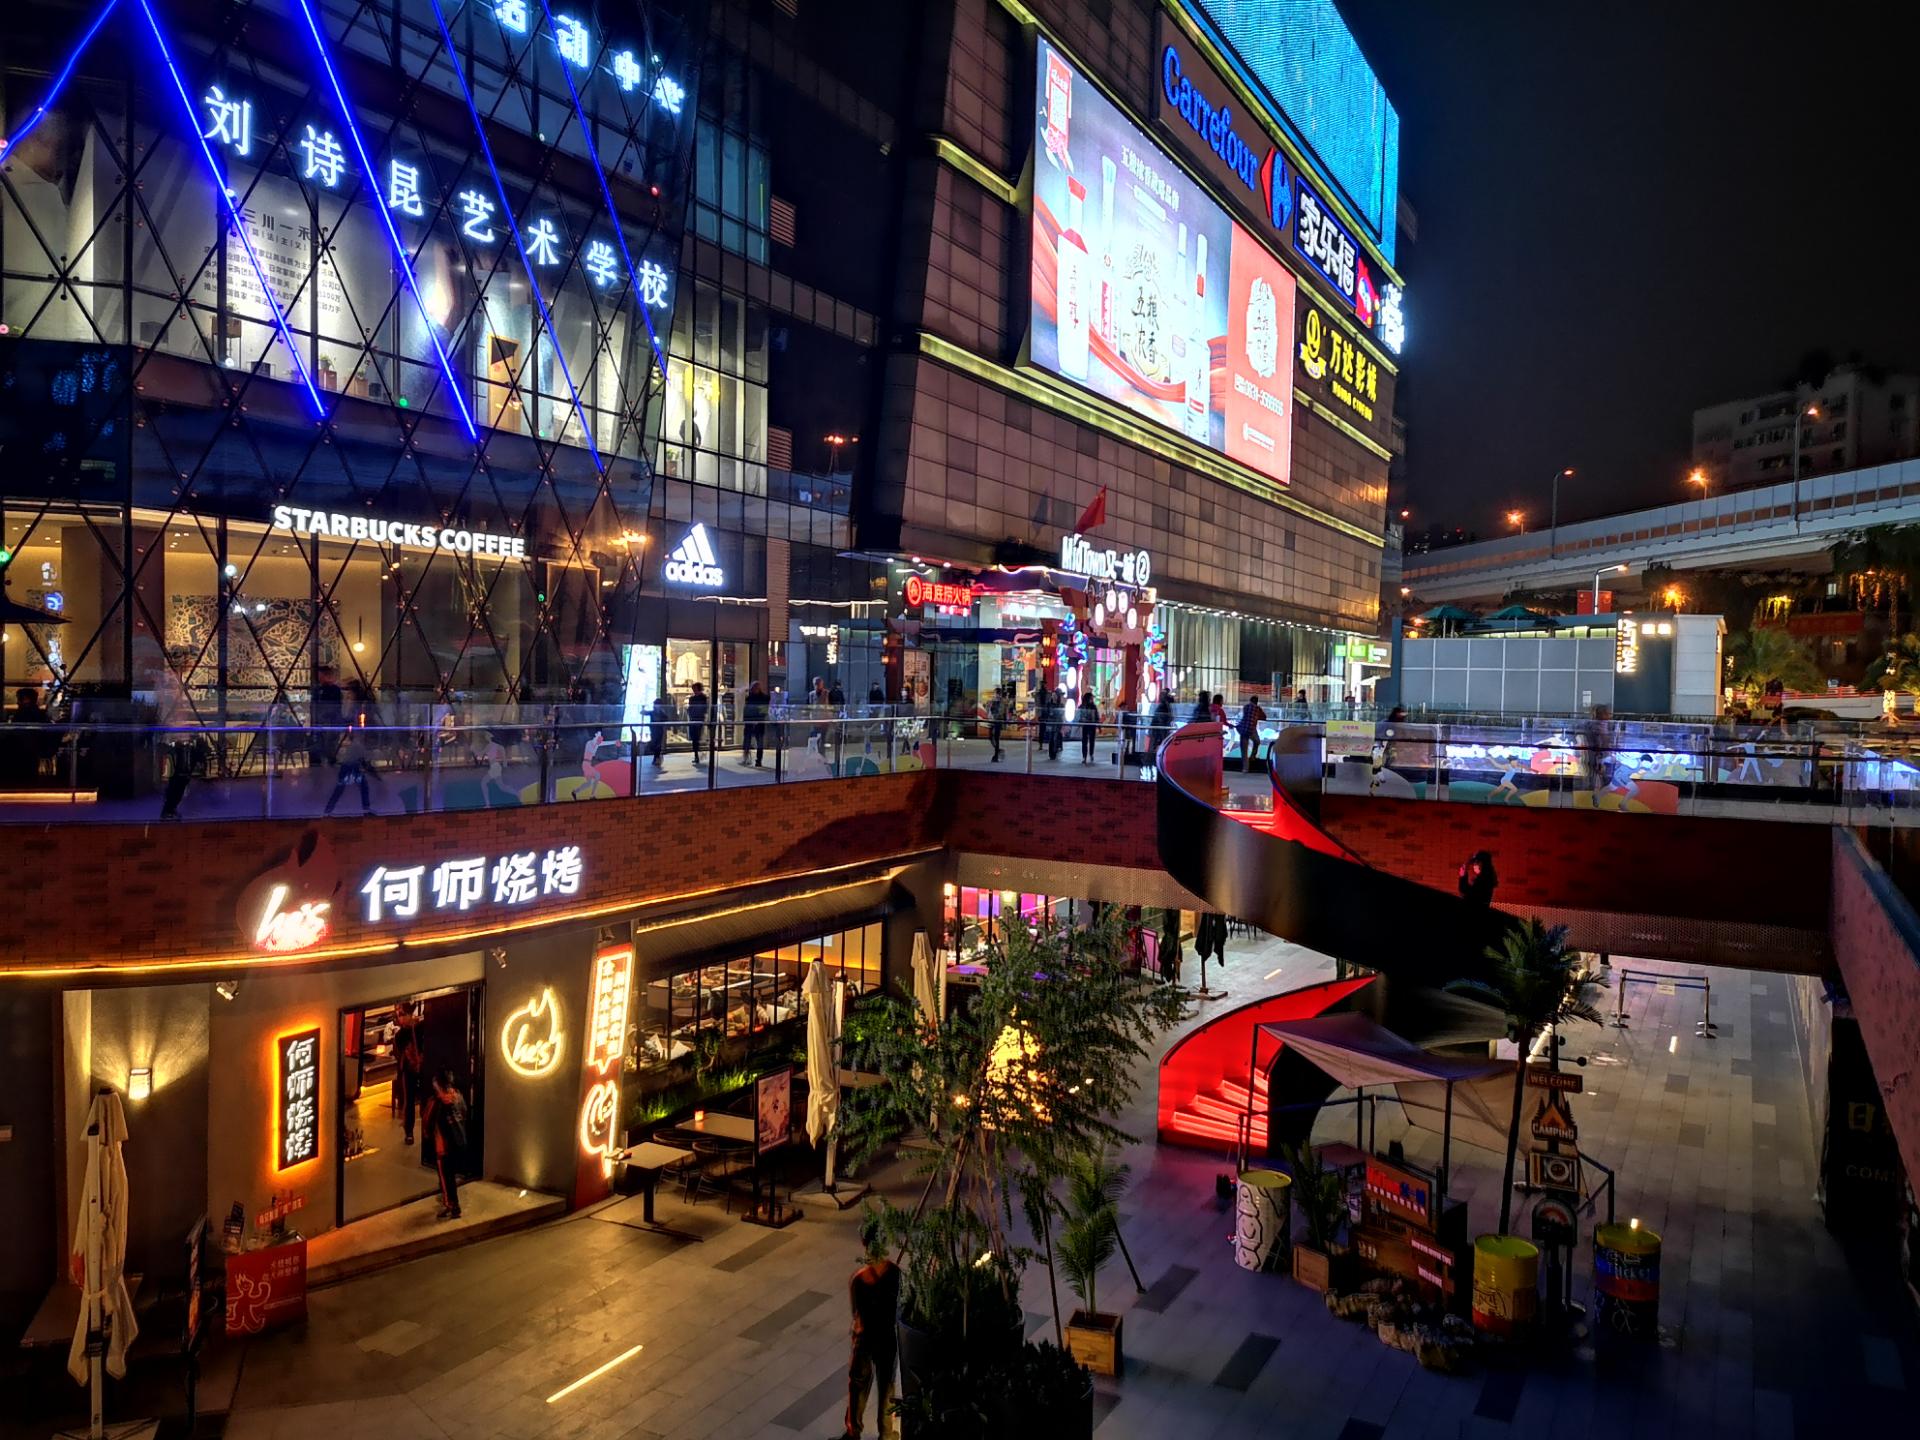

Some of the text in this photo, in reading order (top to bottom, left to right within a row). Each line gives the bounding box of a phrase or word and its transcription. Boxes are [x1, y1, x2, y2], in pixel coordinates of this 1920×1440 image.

[1162, 45, 1258, 192] Carrefour
[204, 85, 669, 309] 刘诗昆艺术学校
[1301, 192, 1356, 296] 家乐福
[1330, 329, 1377, 403] 万达影城
[273, 505, 525, 557] STARBUCKS COFFEE
[665, 560, 723, 587] adidas
[922, 582, 971, 606] 海底捞火锅
[361, 846, 584, 922] 何师烧烤
[286, 1037, 315, 1162] 何师烧烤
[1530, 1073, 1577, 1088] WELCOME
[1532, 1122, 1575, 1140] CAMPING
